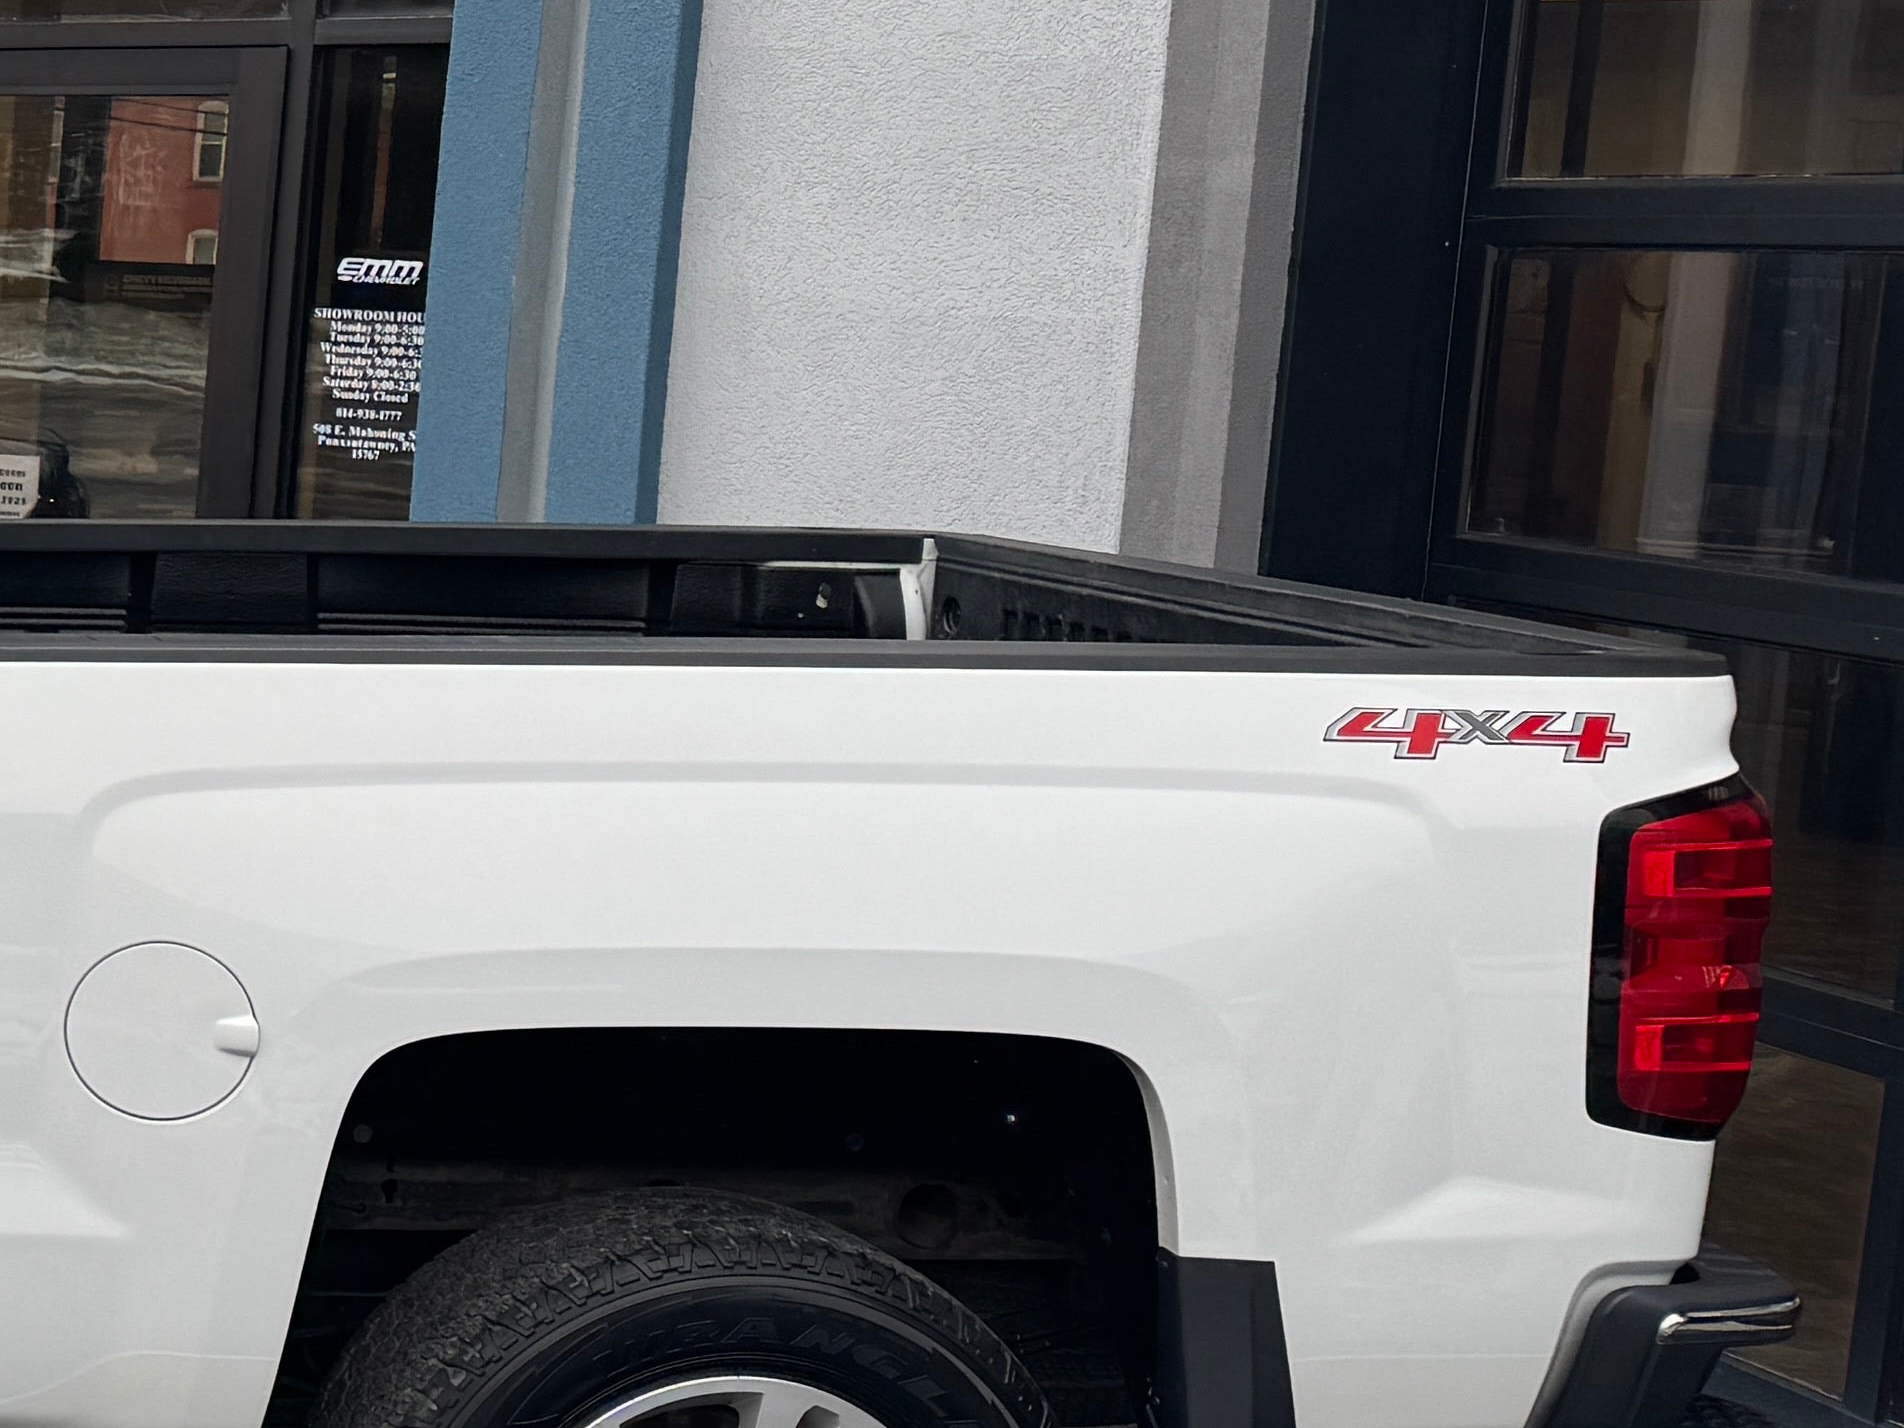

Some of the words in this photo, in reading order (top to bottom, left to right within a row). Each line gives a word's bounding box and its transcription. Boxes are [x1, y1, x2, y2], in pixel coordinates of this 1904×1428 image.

[313, 307, 395, 322] SHOWROOM
[396, 311, 426, 323] HOU
[330, 320, 372, 334] Monday
[330, 331, 371, 348] Tuesday
[320, 341, 379, 357] Wednesday
[325, 353, 372, 368] Thursday
[330, 365, 363, 379] Friday
[322, 376, 369, 391] Saturday
[332, 388, 370, 403] Sunday
[373, 391, 409, 403] Closed
